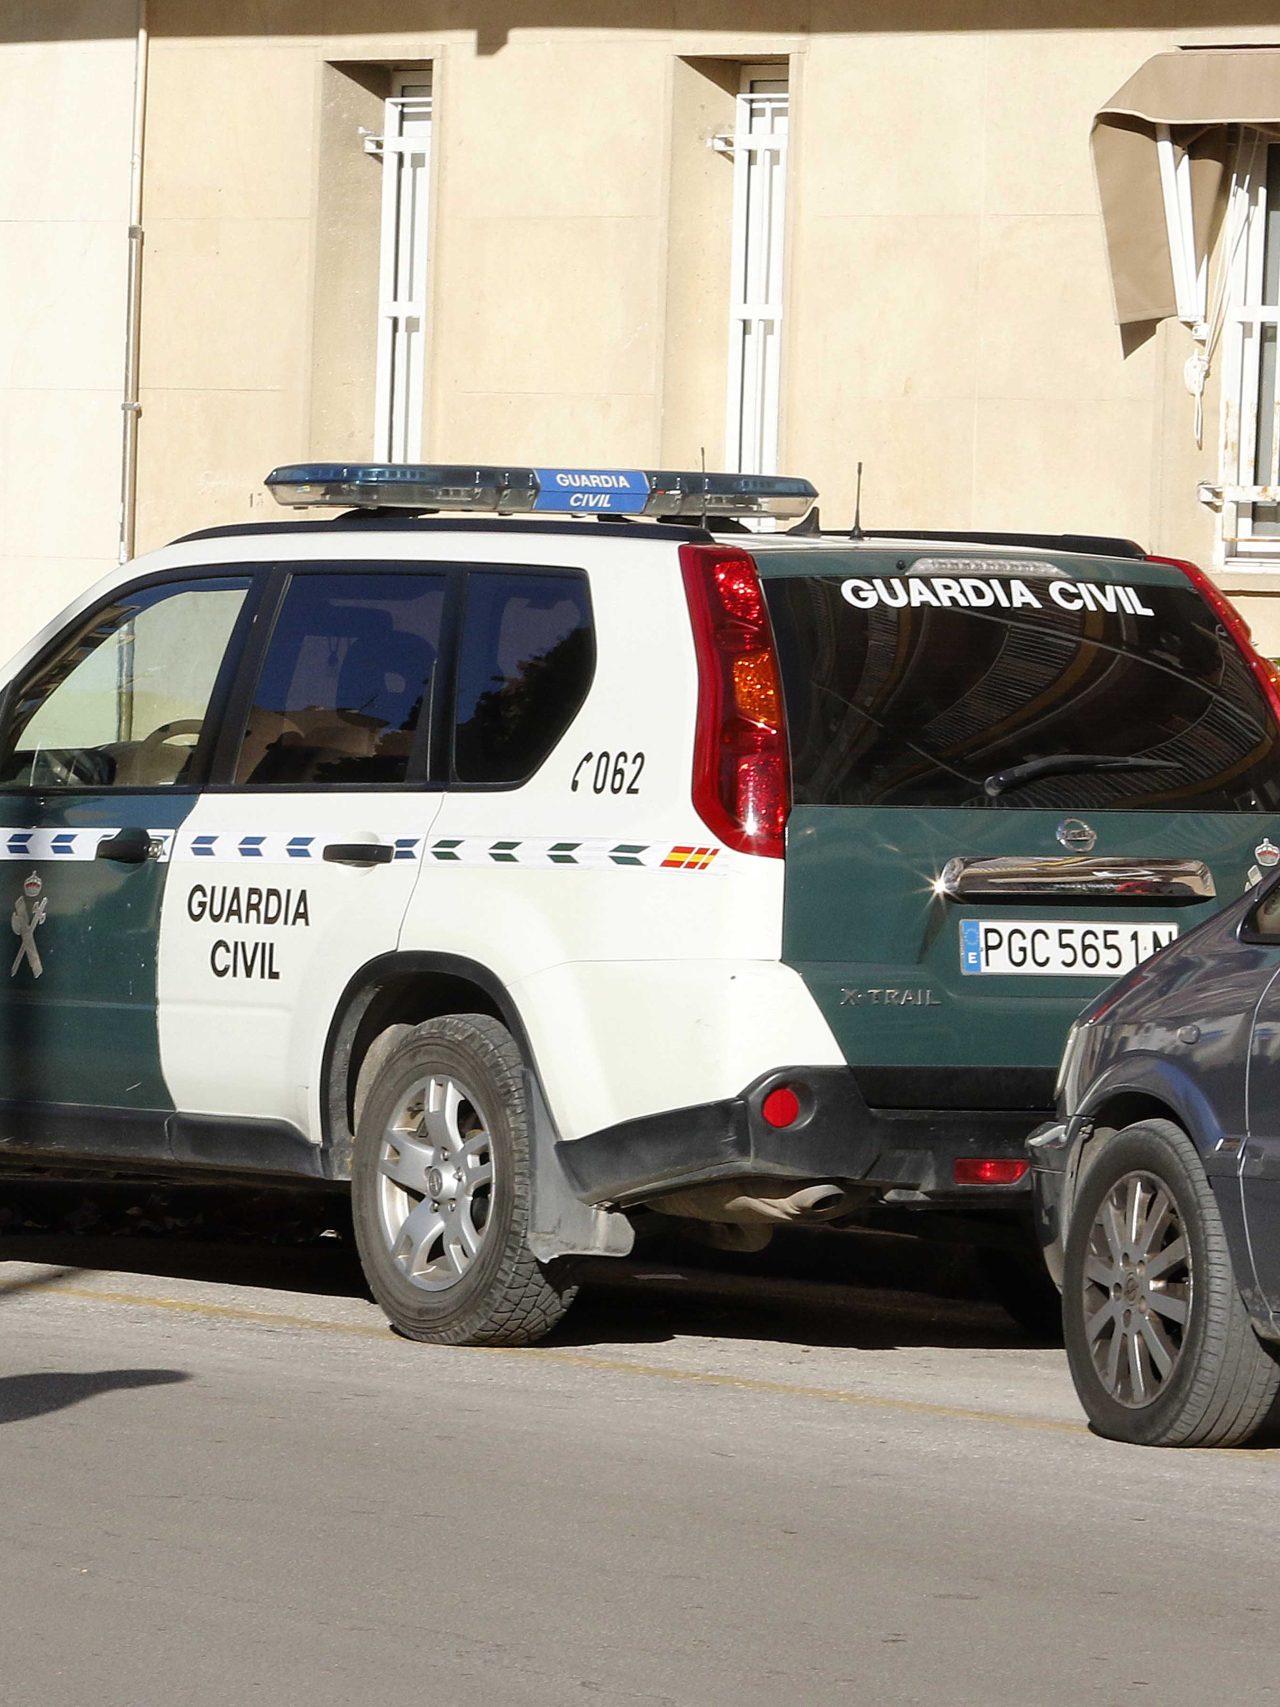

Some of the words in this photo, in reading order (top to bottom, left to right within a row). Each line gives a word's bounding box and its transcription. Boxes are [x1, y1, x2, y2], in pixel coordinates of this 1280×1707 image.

[556, 473, 630, 489] GUARDIA
[569, 493, 612, 508] CIVIL
[840, 577, 1043, 609] GUARDIA
[1048, 580, 1155, 617] CIVIL
[593, 751, 645, 795] 062
[187, 884, 310, 926] GUARDIA
[210, 939, 280, 980] CIVIL
